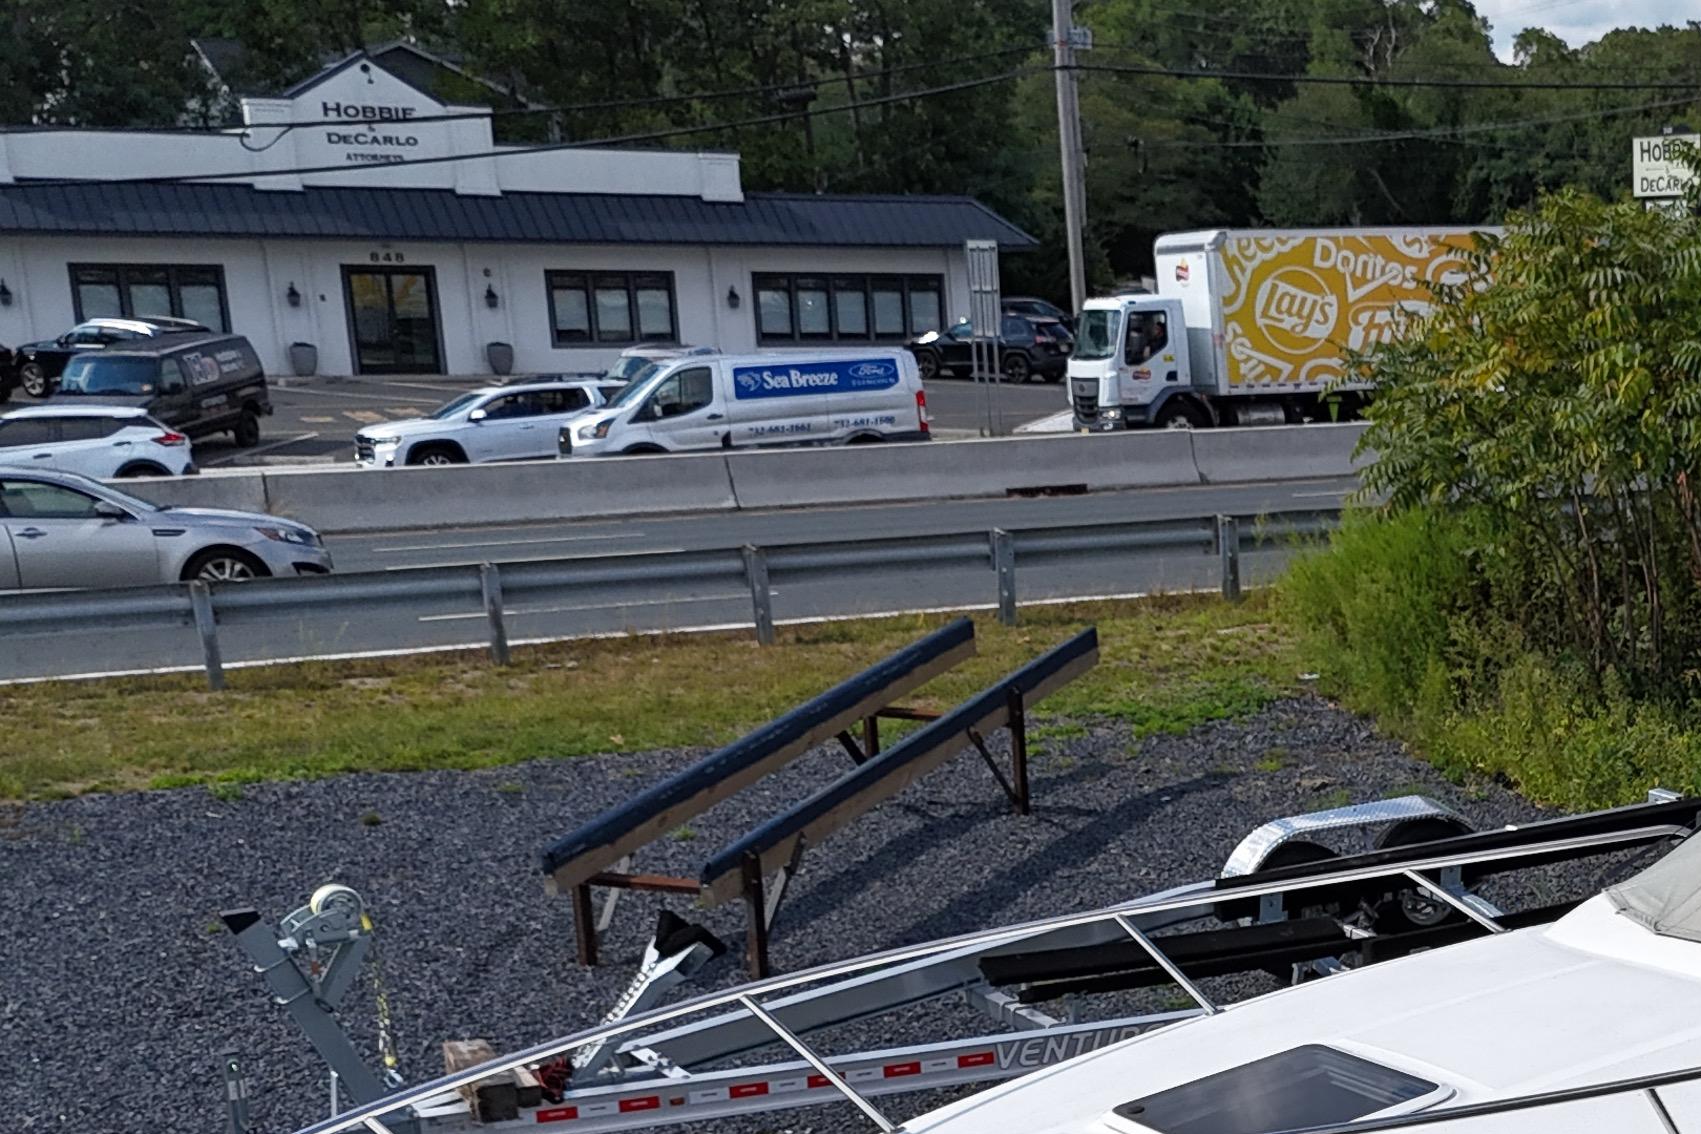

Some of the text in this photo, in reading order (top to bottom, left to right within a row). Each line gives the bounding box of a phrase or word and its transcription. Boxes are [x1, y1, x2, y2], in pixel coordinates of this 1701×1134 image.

[322, 102, 416, 120] HOBBIE
[326, 132, 419, 147] DECARLO
[370, 252, 405, 262] 848
[1314, 237, 1418, 290] Doritos
[762, 371, 790, 390] Sea
[789, 369, 839, 388] Breeze
